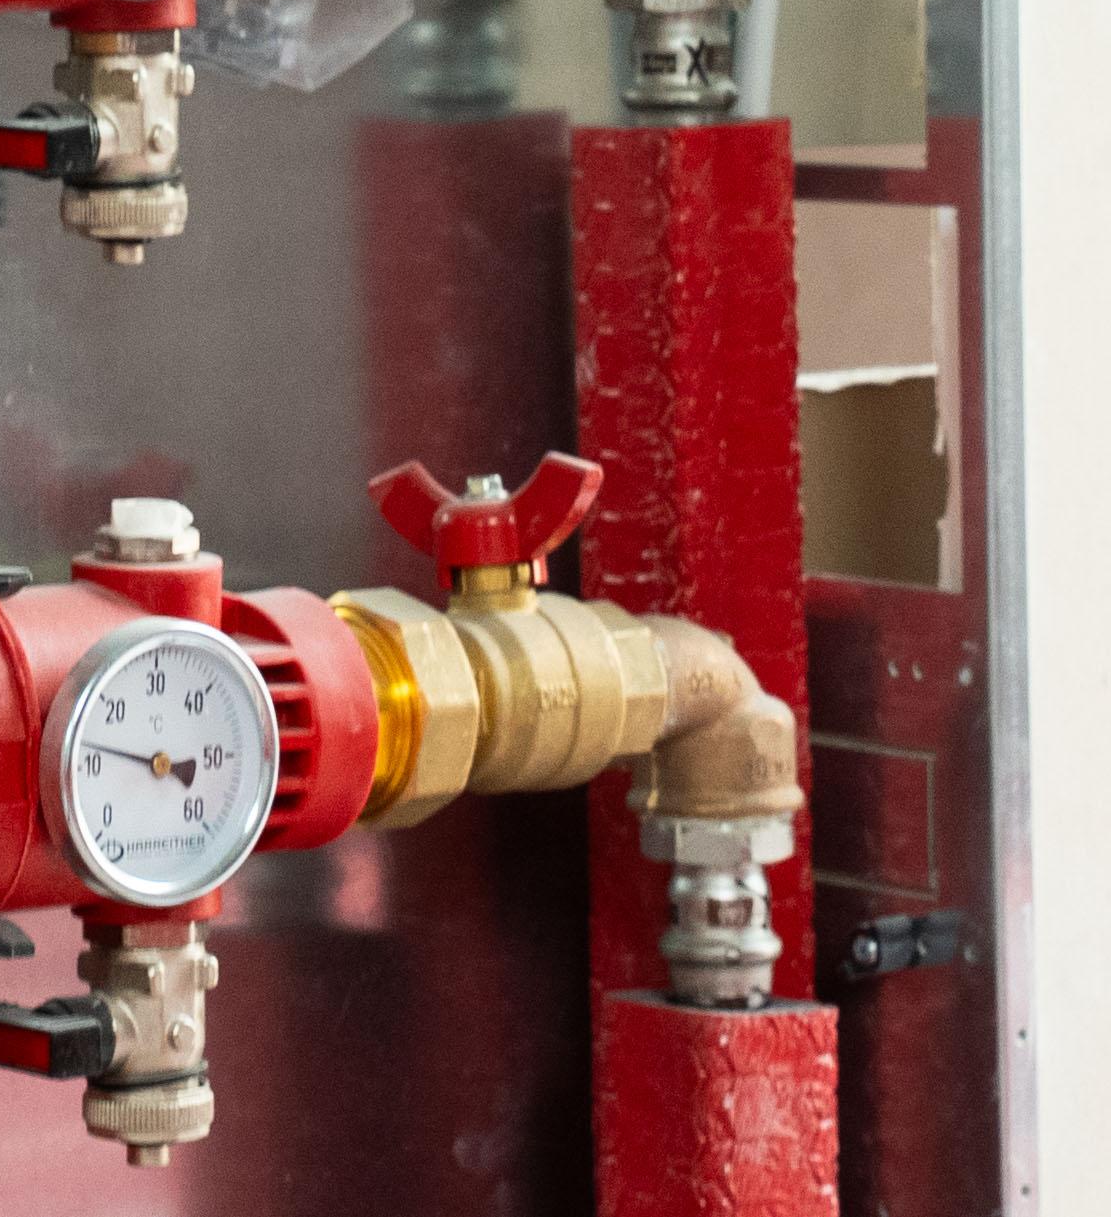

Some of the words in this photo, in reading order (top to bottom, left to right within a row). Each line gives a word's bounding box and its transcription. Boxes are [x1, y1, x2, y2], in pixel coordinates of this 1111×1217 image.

[146, 671, 165, 696] 30
[105, 699, 126, 724] 20
[184, 691, 204, 715] 40
[84, 752, 102, 777] 10
[203, 744, 223, 770] 50
[102, 802, 113, 827] 0
[183, 797, 204, 822] 60
